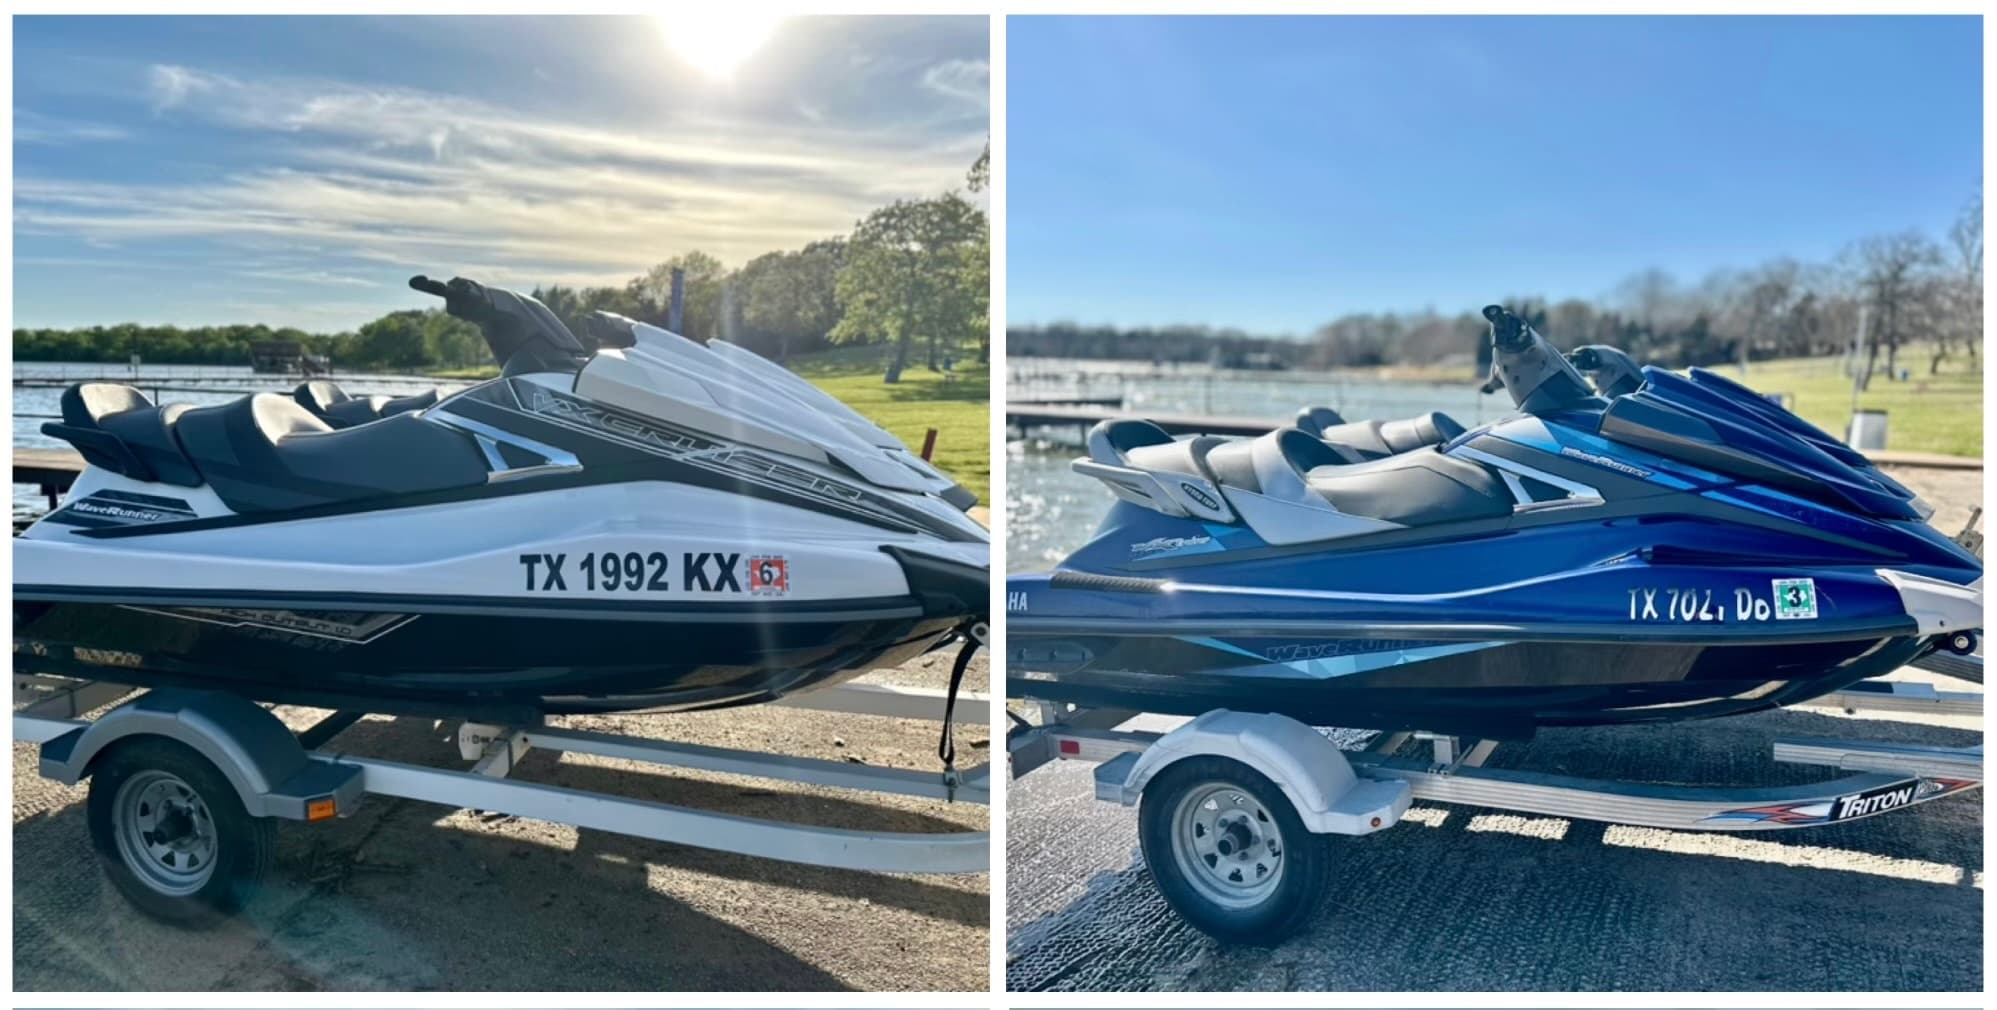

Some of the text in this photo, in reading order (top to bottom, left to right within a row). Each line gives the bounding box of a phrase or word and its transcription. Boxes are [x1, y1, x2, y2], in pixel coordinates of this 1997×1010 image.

[73, 502, 159, 520] WaveRunner
[520, 553, 567, 591] TX
[579, 552, 669, 592] 1992
[683, 552, 742, 593] KX
[760, 561, 773, 586] 6
[1007, 591, 1028, 611] HA
[1628, 587, 1659, 620] TX
[1788, 585, 1802, 608] 3
[1839, 787, 1912, 819] TRITON
